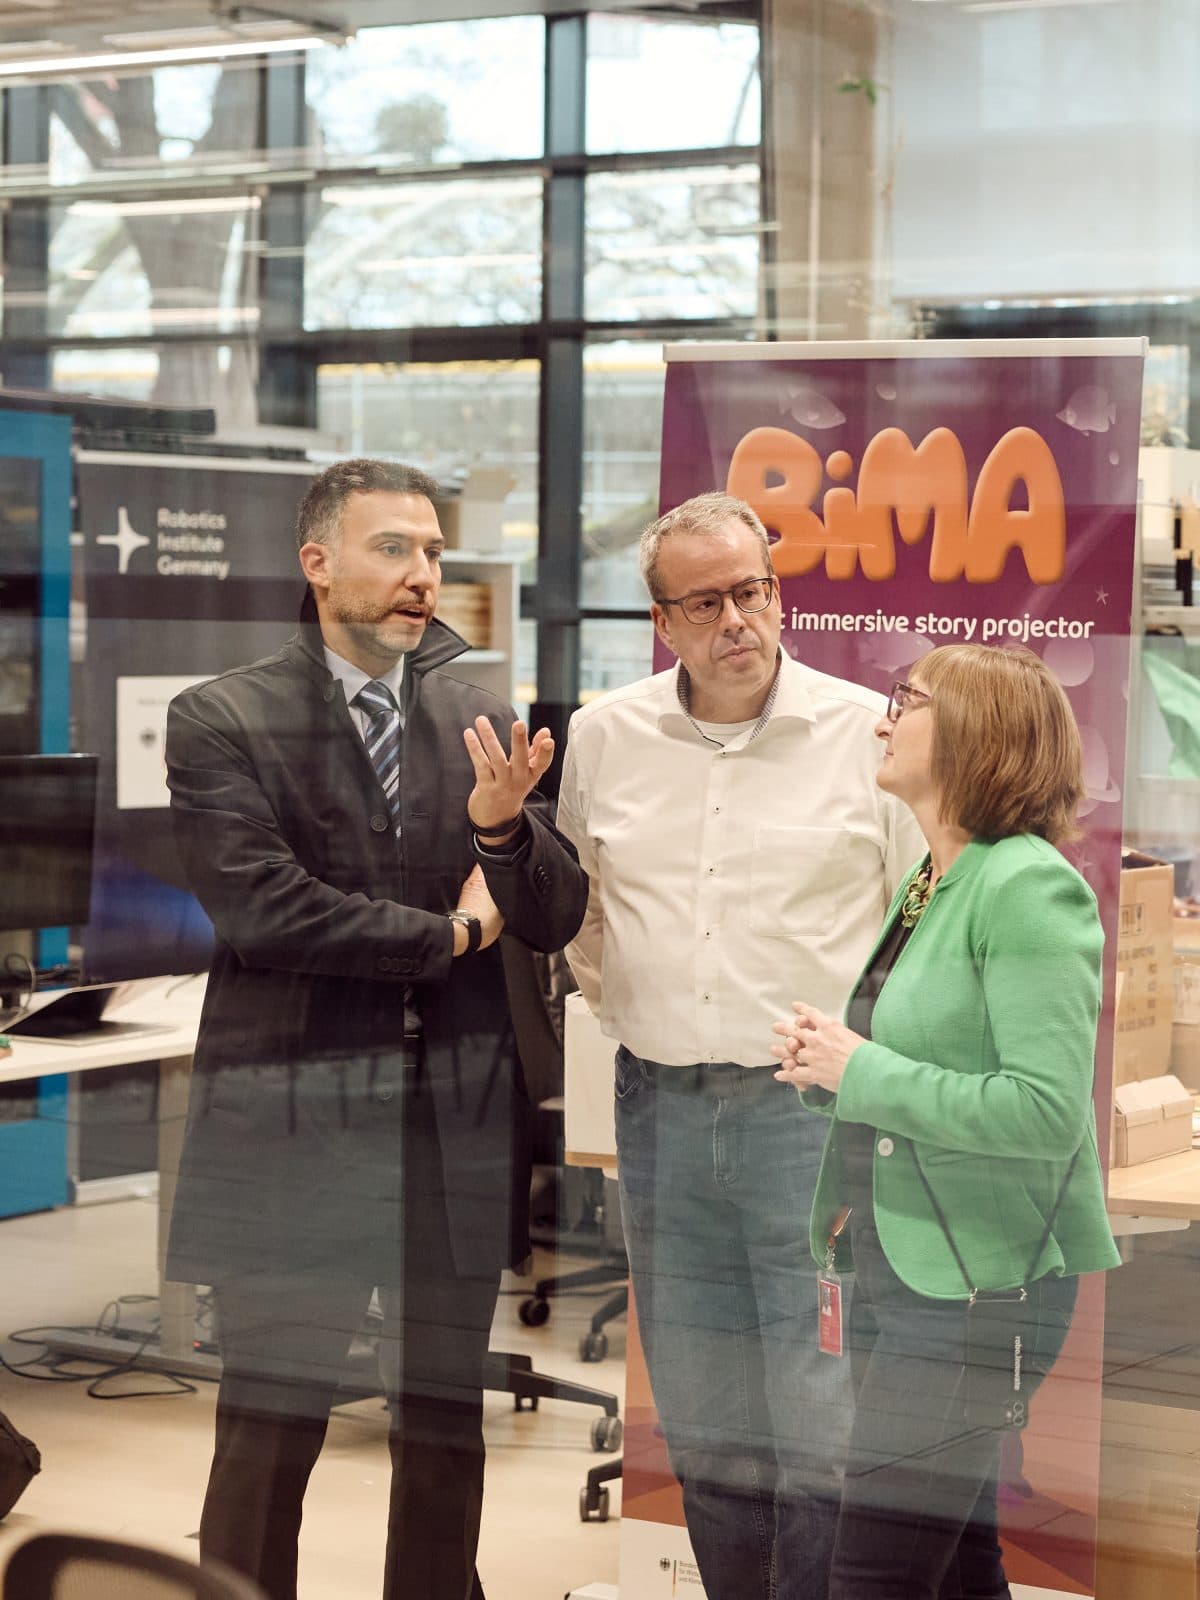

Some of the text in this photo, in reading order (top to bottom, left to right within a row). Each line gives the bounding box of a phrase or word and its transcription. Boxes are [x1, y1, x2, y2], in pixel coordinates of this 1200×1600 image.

[157, 507, 226, 529] Robotics
[157, 532, 224, 552] Institute
[157, 555, 230, 580] Germany
[791, 607, 909, 633] immersive
[914, 613, 977, 640] story
[982, 613, 1095, 642] projector
